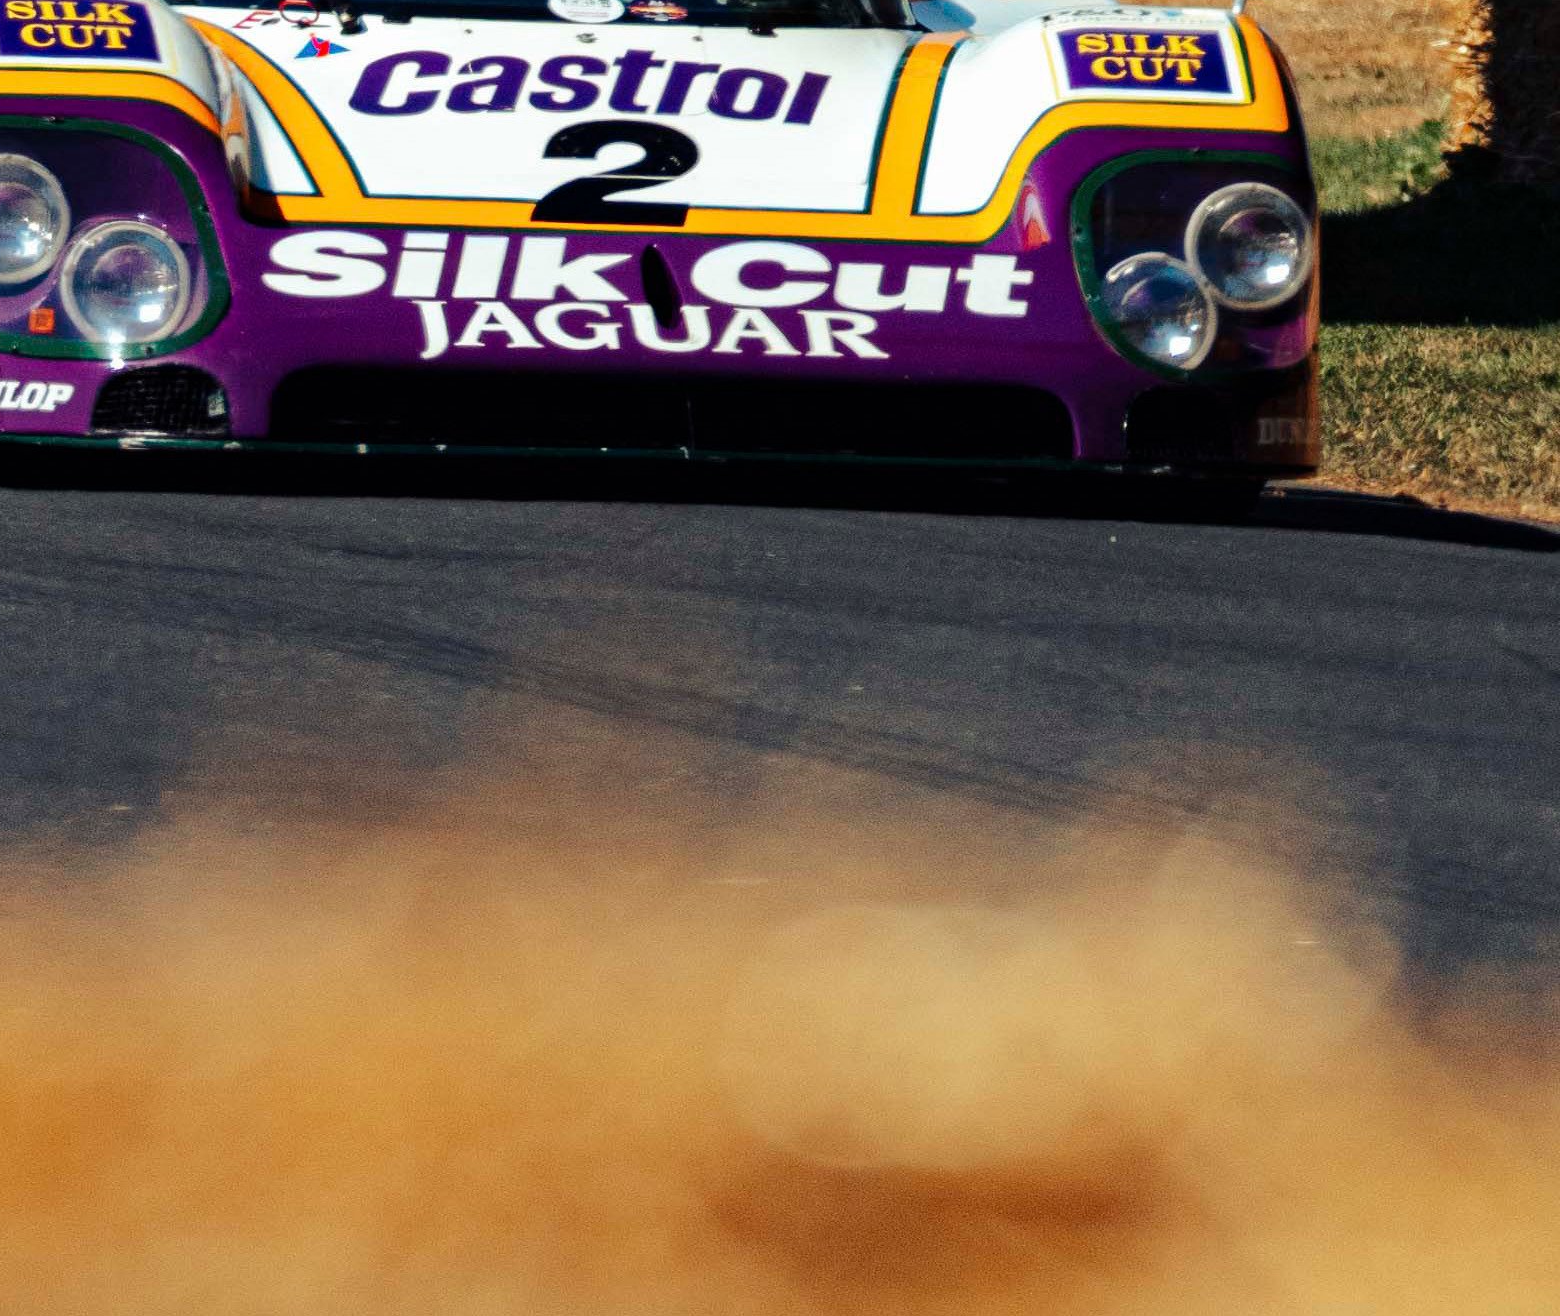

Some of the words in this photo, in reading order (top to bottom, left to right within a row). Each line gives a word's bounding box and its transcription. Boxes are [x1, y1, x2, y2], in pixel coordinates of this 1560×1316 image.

[5, 0, 137, 26] SILK
[20, 24, 132, 49] CUT
[1076, 33, 1207, 56] SILK
[348, 49, 831, 125] Castrol
[1091, 56, 1203, 83] CUT
[530, 119, 700, 228] 2
[262, 230, 633, 303] Silk
[691, 240, 1034, 318] Cut
[412, 299, 891, 360] JAGUAR
